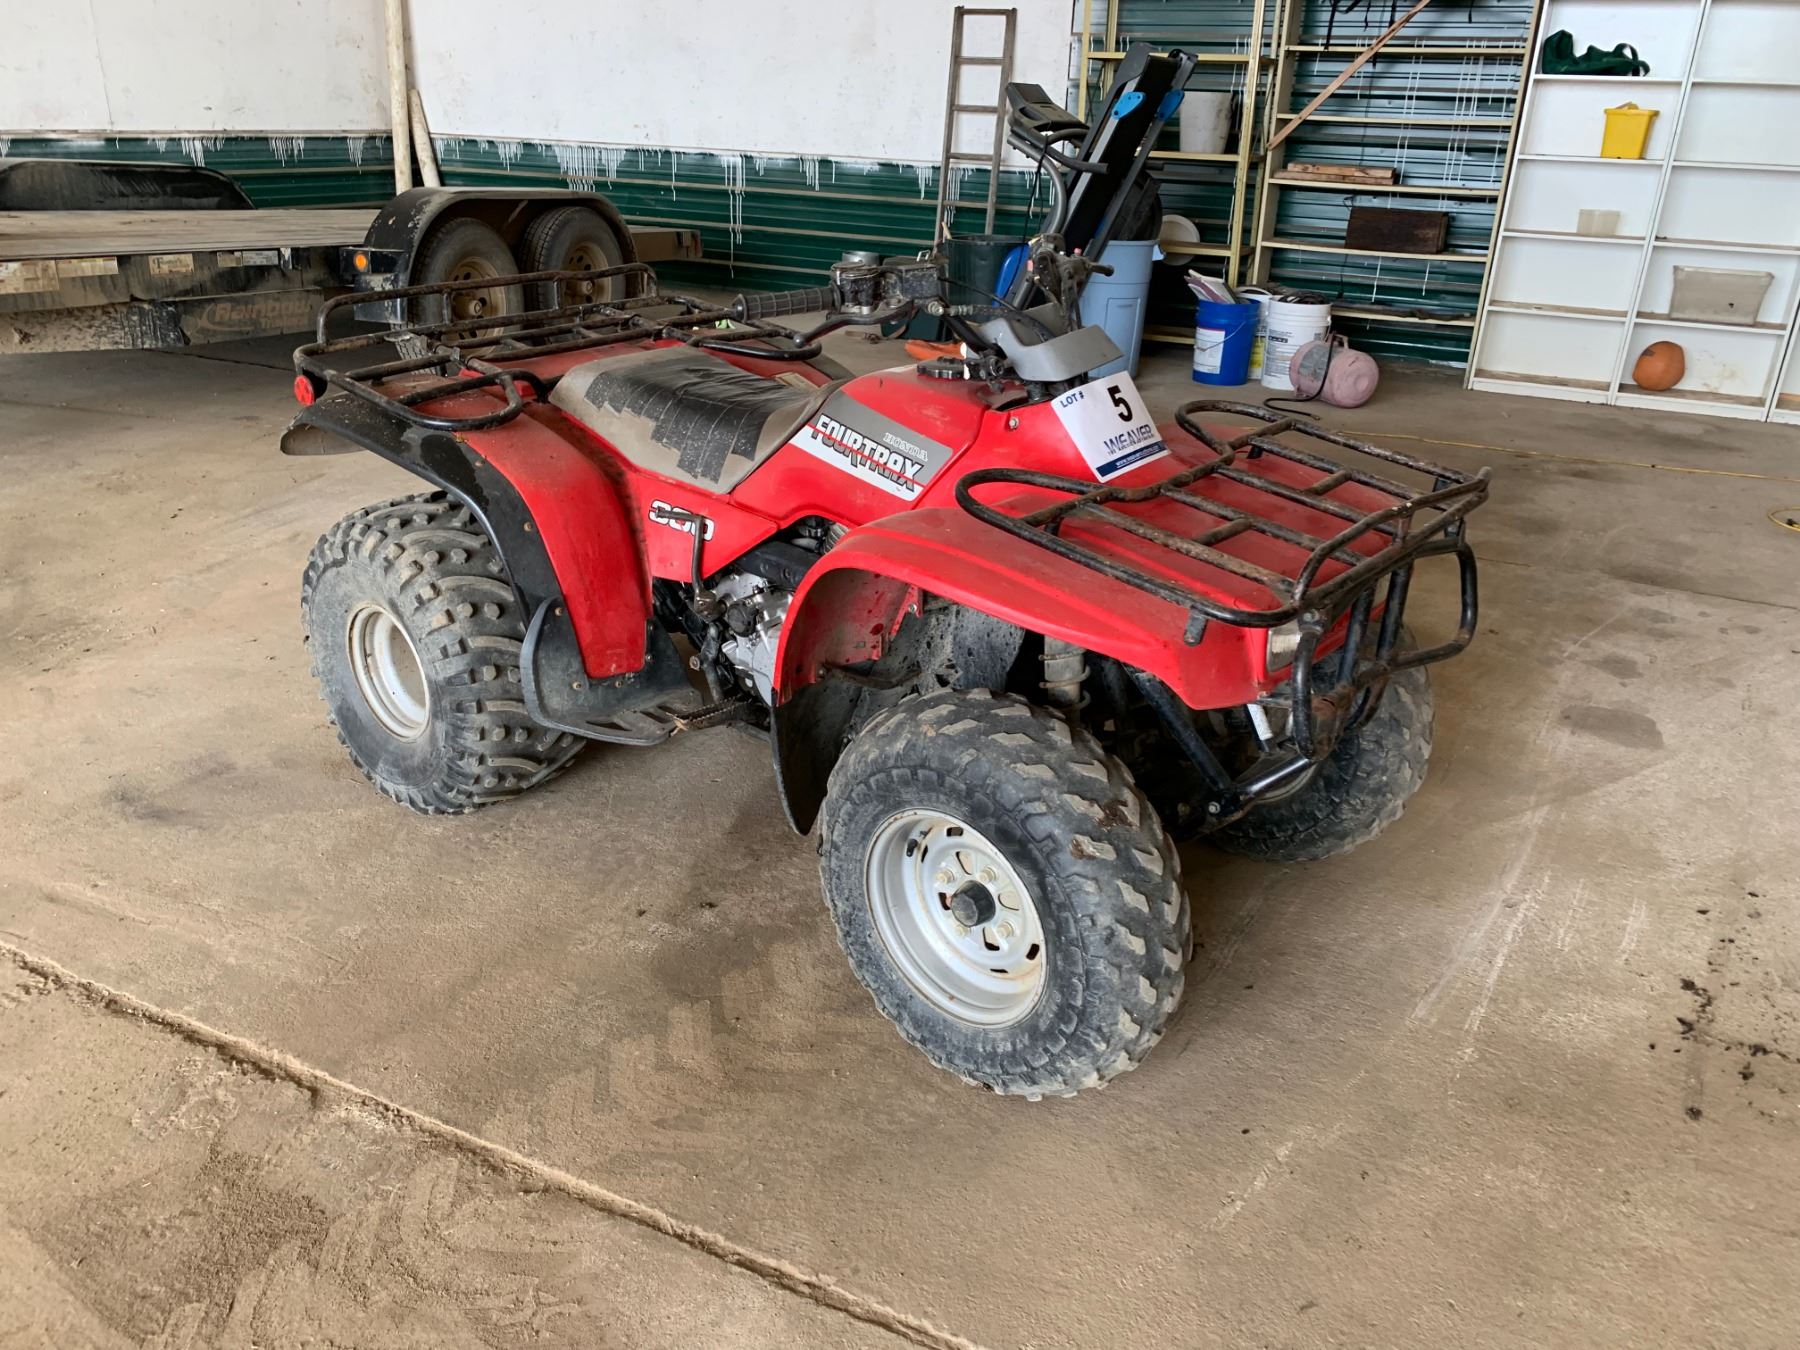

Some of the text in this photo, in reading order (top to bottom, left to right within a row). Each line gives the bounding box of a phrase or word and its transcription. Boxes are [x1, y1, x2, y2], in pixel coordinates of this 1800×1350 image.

[1060, 393, 1078, 408] LOT
[1107, 385, 1133, 422] 5
[883, 432, 929, 462] HONDA
[1103, 424, 1152, 450] WEAVER
[811, 413, 925, 493] FOURTRAX
